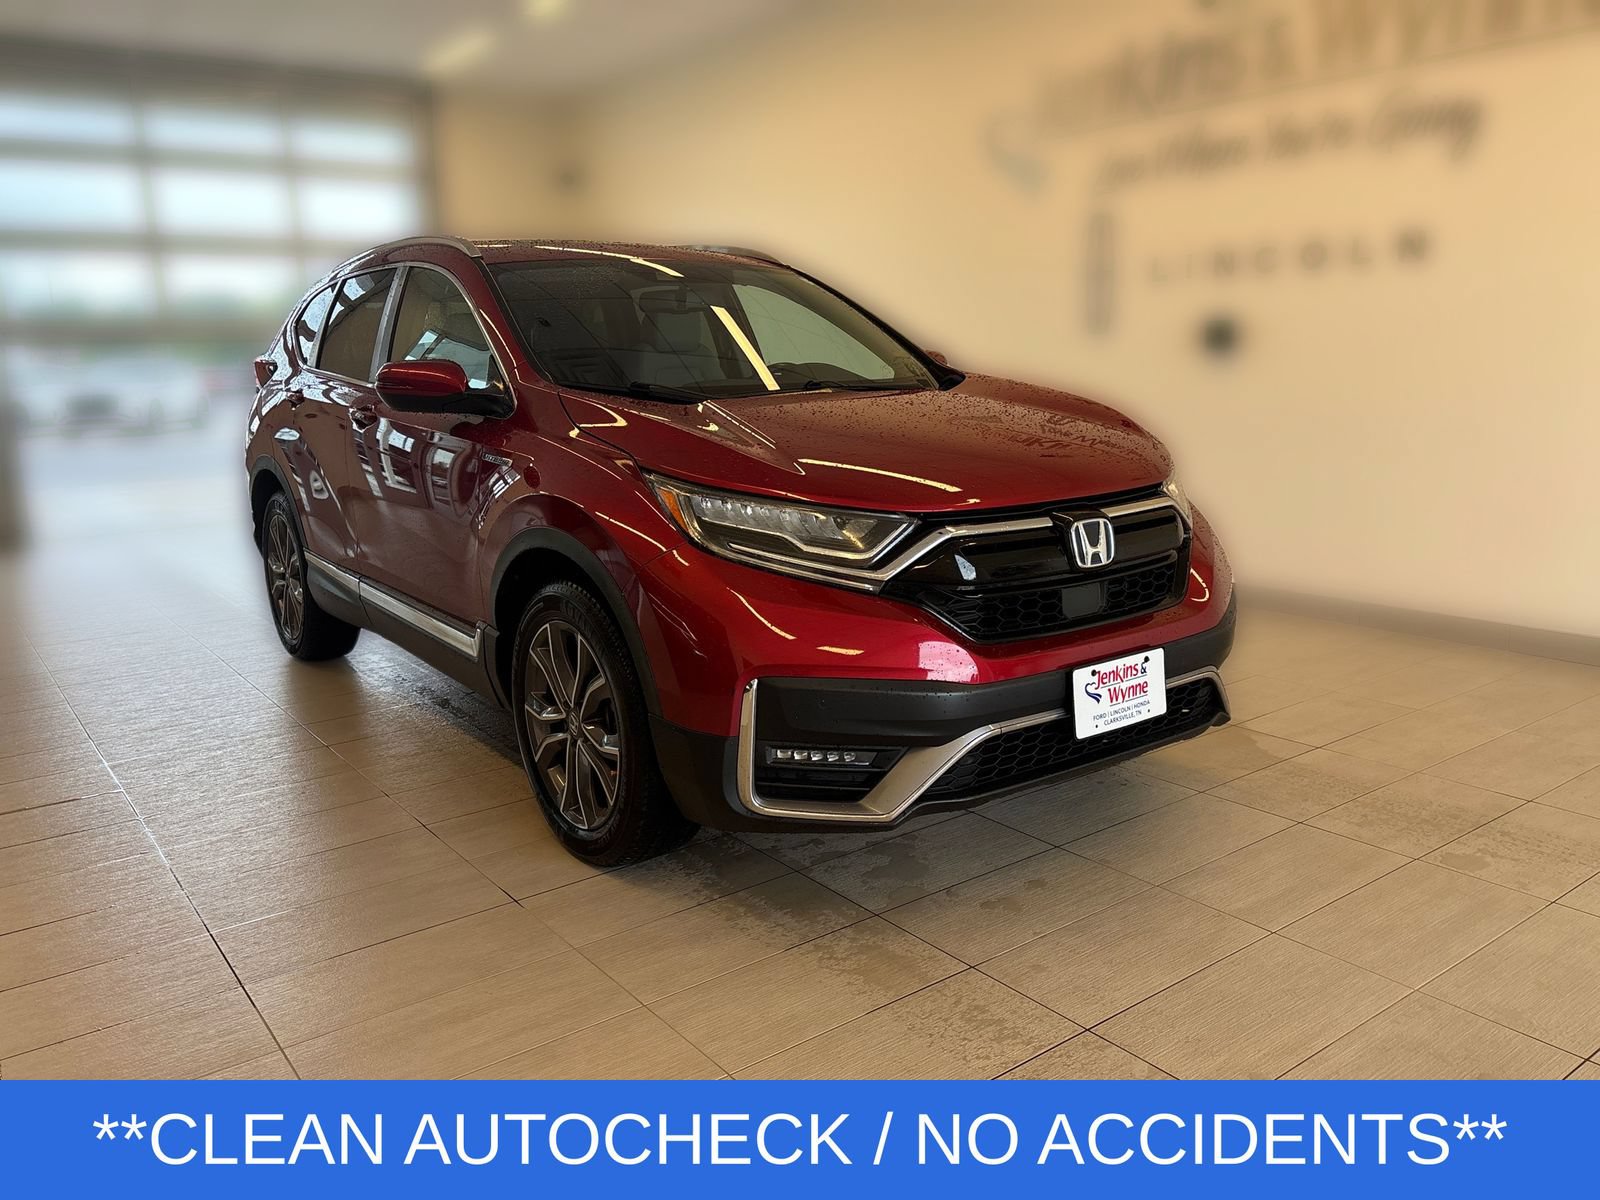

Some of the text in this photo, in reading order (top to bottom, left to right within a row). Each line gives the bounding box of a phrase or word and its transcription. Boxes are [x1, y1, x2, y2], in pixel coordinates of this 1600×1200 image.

[1149, 229, 1432, 284] LINCOLN
[1094, 663, 1139, 690] Jenkins
[1108, 681, 1148, 703] Wynne
[1093, 713, 1107, 721] FORD
[1110, 706, 1131, 717] LINCOLN
[1134, 700, 1150, 710] HONDA
